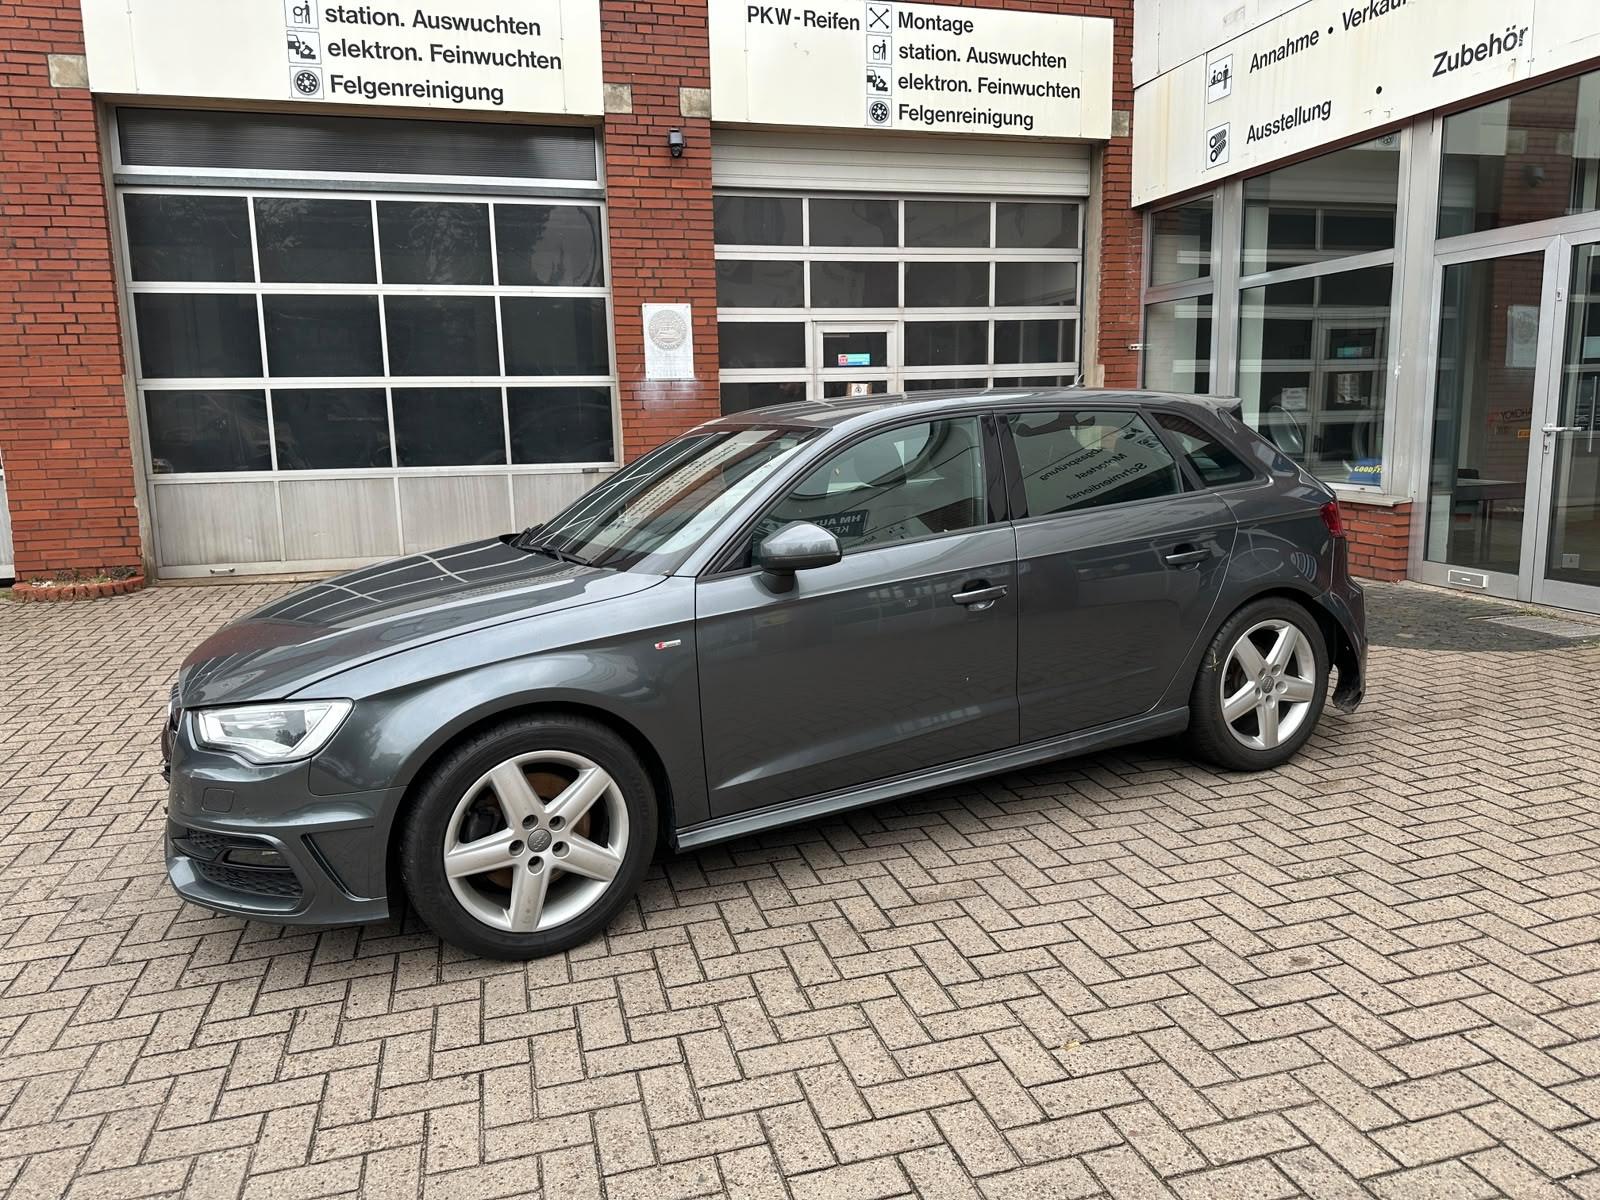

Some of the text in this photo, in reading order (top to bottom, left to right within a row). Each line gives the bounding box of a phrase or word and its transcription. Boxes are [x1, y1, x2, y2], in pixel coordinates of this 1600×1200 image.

[325, 5, 541, 36] station. Auswuchten
[747, 5, 974, 35] PKW-Reifen Montage
[1249, 0, 1407, 73] Annahme Verkau
[327, 38, 562, 70] elektron. Feinwuchten
[899, 43, 1067, 69] station. Auswuchten
[330, 74, 504, 105] Felgenreinigung
[898, 73, 1081, 99] elektron. Feinwuchten
[1246, 24, 1529, 145] Ausstellung Zubehör
[898, 103, 1034, 130] Felgenreinigung
